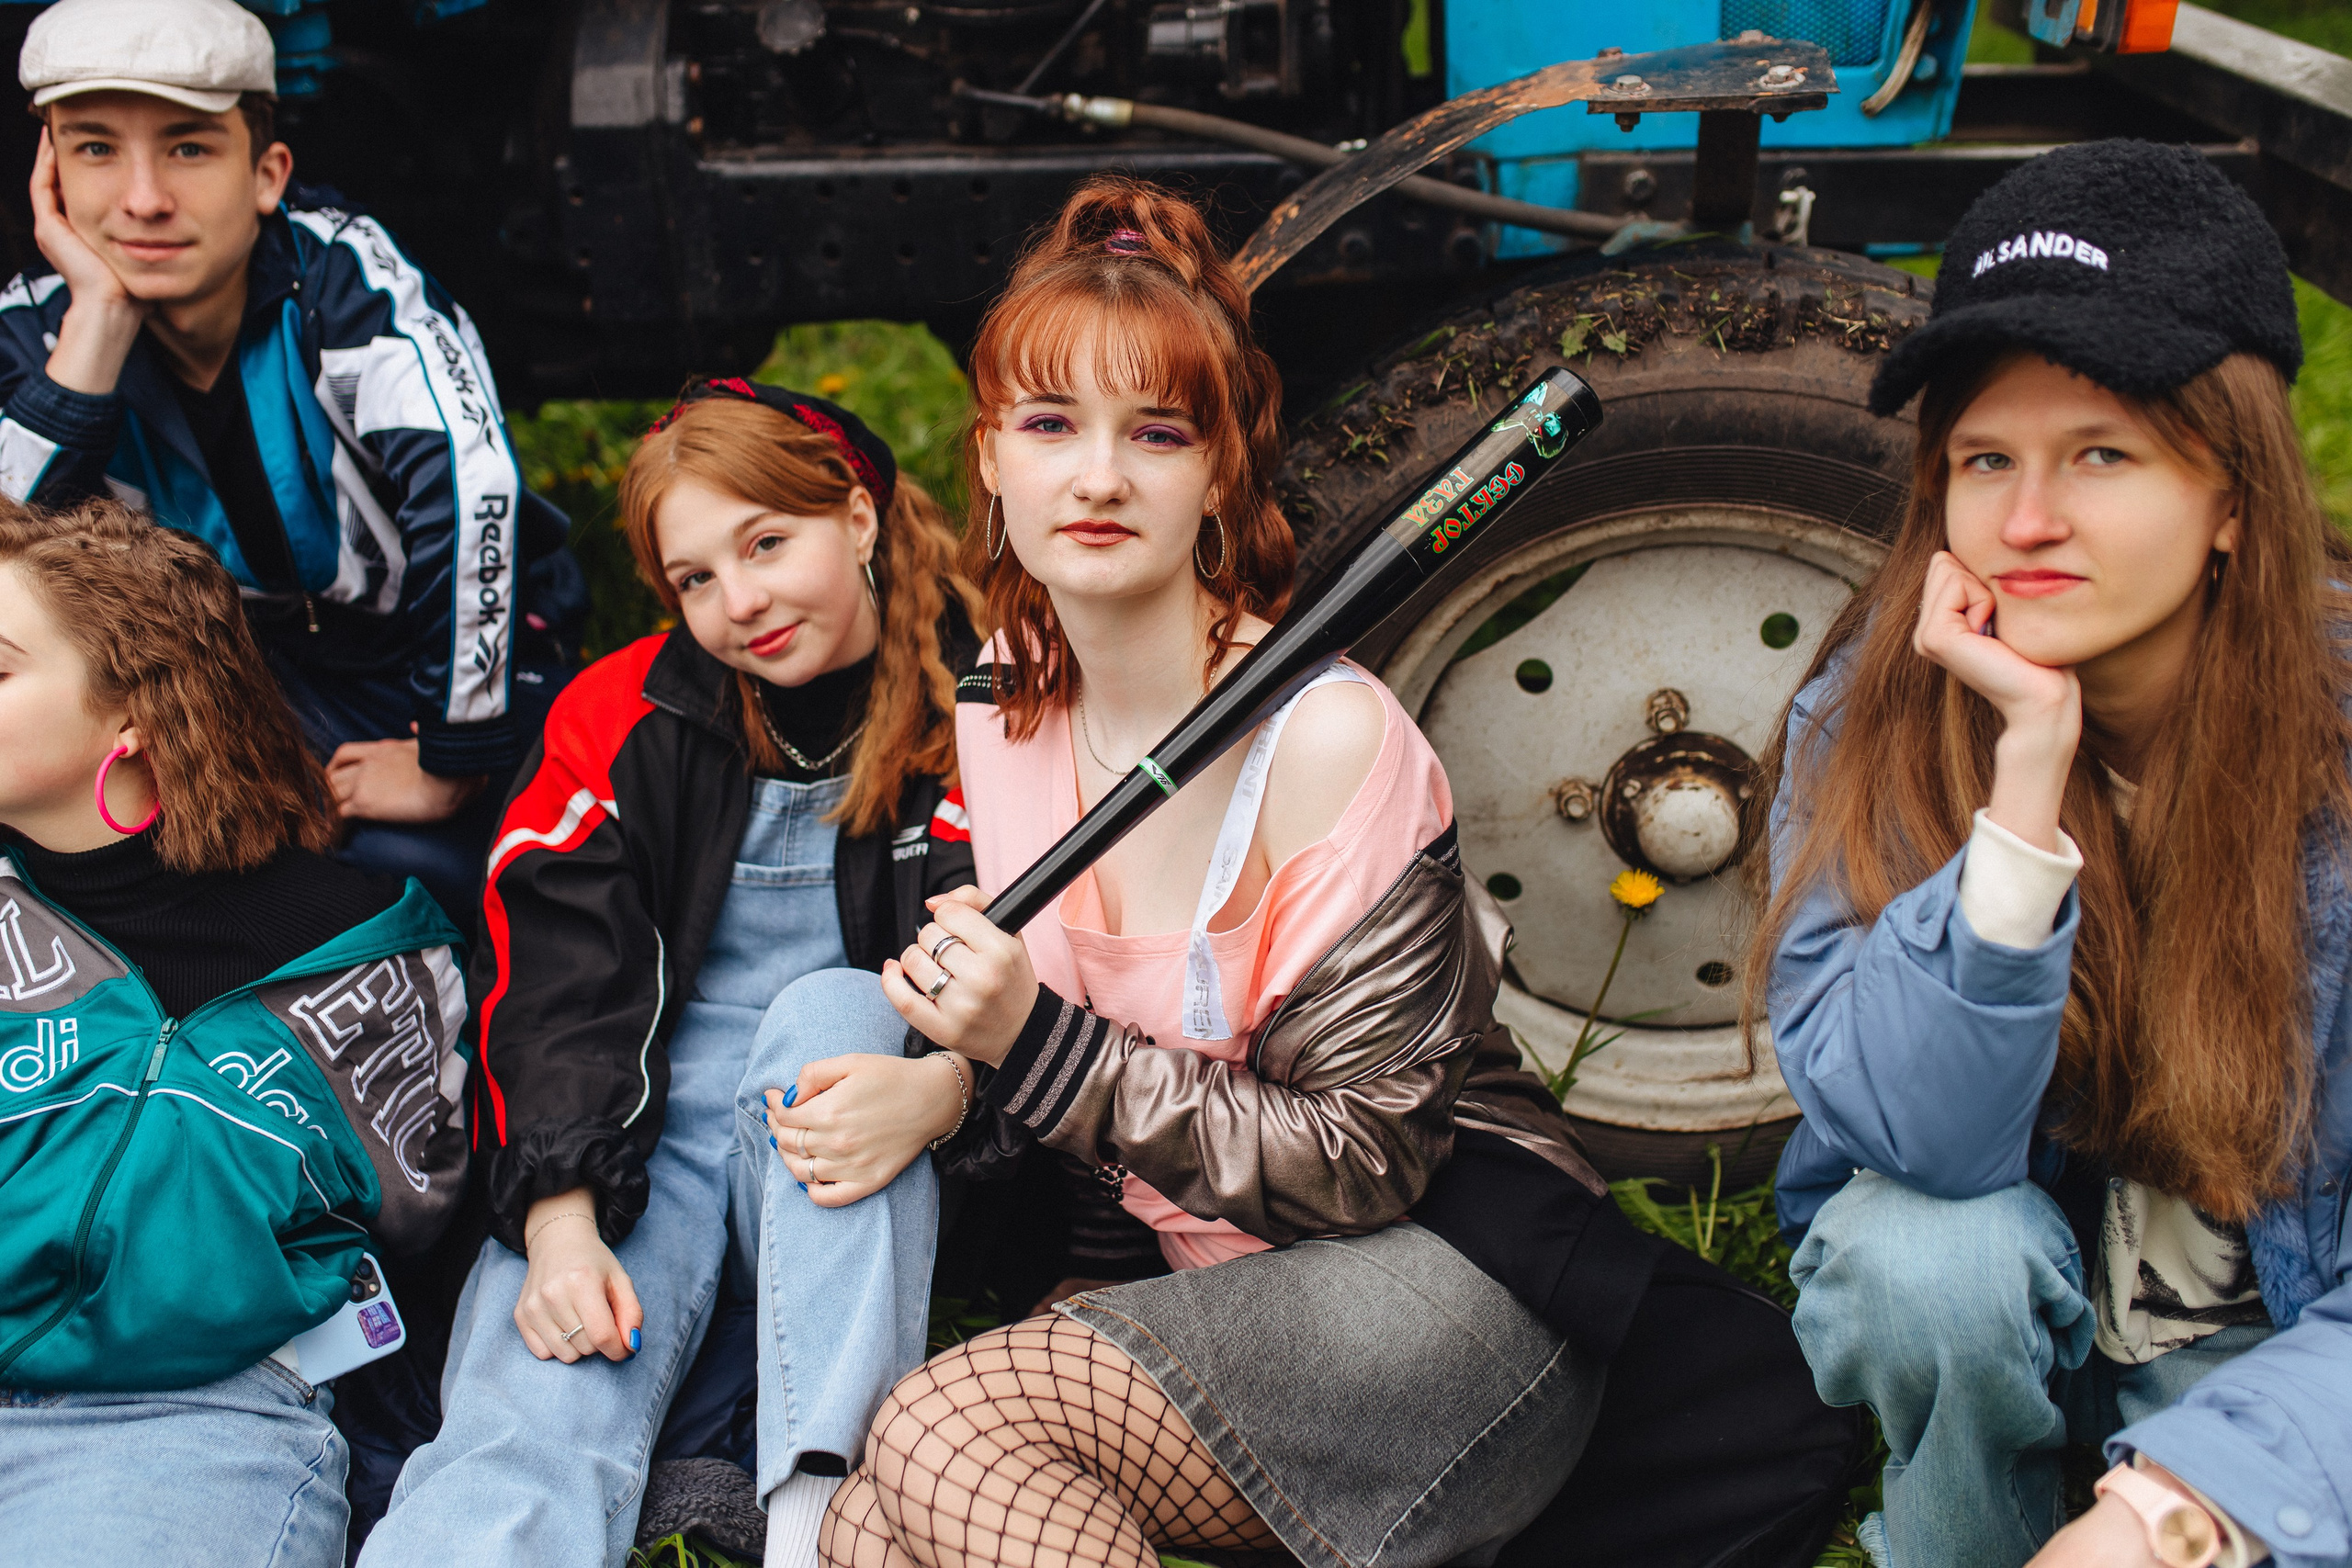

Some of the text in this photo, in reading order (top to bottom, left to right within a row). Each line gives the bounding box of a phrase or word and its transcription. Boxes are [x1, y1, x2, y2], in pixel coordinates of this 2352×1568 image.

[1996, 231, 2109, 271] SANDER
[1401, 466, 1476, 528] ГАЗА
[1430, 461, 1526, 553] СЕКТОР
[474, 494, 509, 626] Reebok
